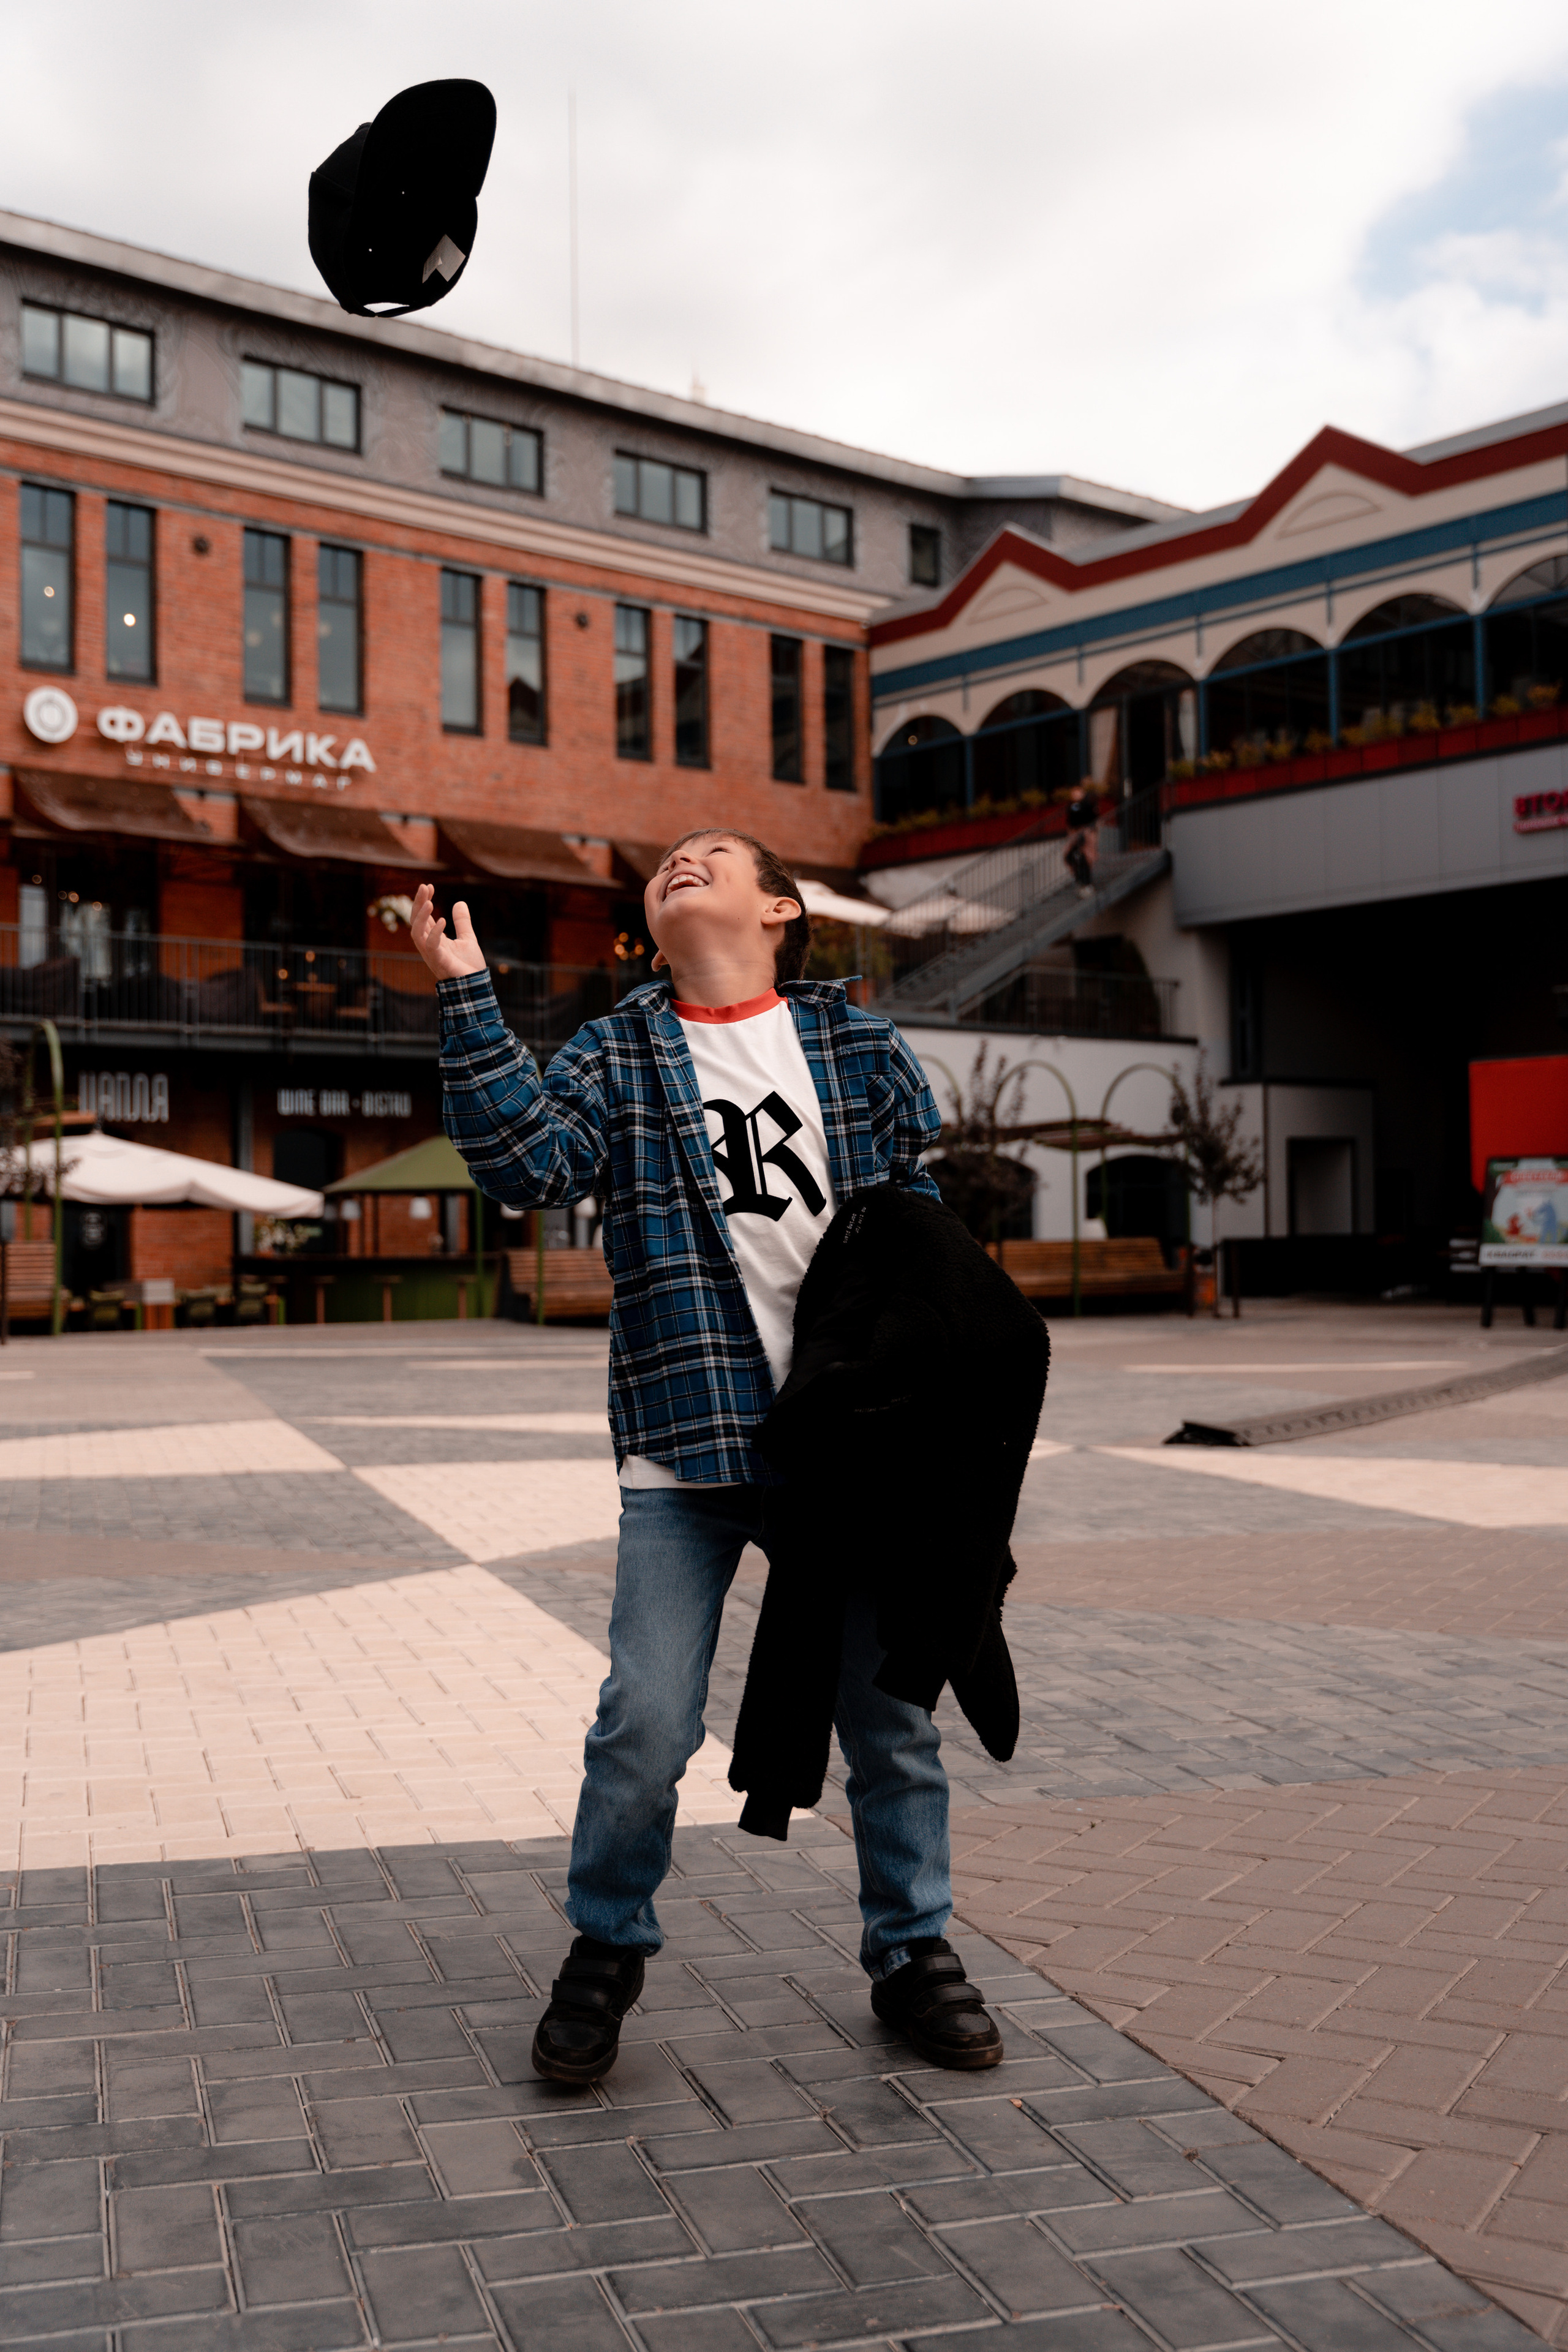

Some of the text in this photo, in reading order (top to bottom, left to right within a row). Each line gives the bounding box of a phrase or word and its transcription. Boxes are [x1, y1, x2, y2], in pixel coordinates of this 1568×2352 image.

[96, 705, 377, 772] ФАБРИКА
[126, 750, 352, 791] УНИВЕРМАГ
[277, 1088, 412, 1118] WINE BAR BISTRO
[846, 1213, 857, 1229] boring
